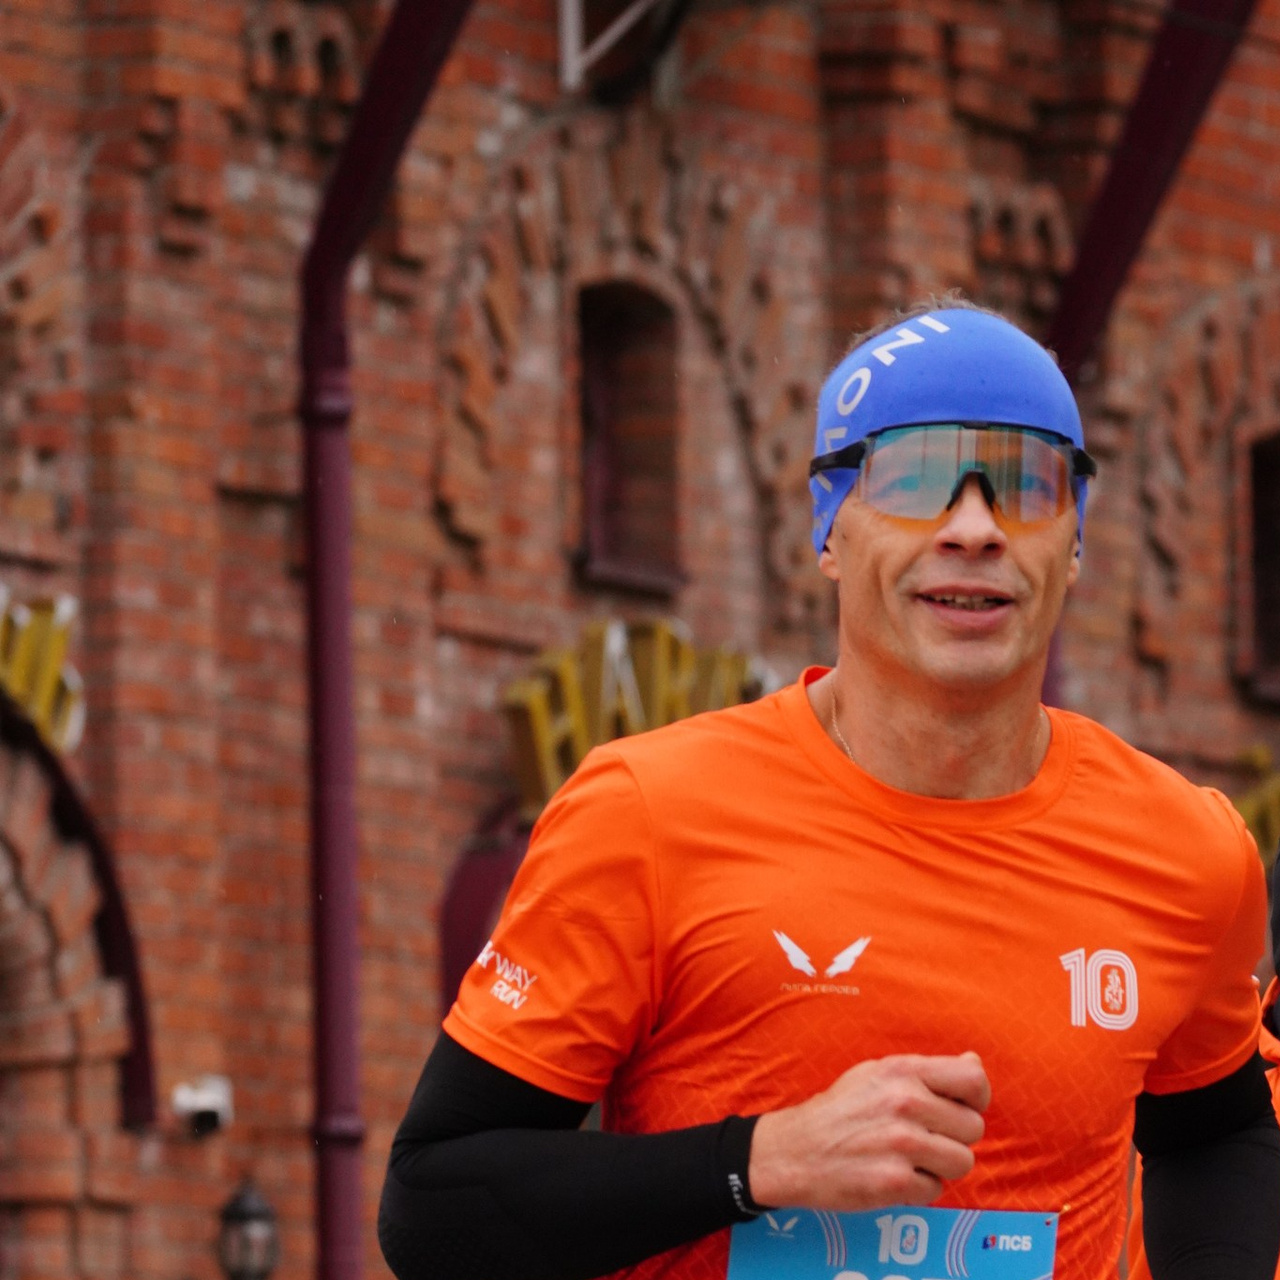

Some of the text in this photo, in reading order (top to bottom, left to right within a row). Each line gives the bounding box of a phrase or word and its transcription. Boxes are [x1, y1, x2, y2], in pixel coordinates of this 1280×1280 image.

[489, 979, 528, 1010] RUN
[1059, 946, 1140, 1031] 10
[874, 1213, 930, 1266] 10
